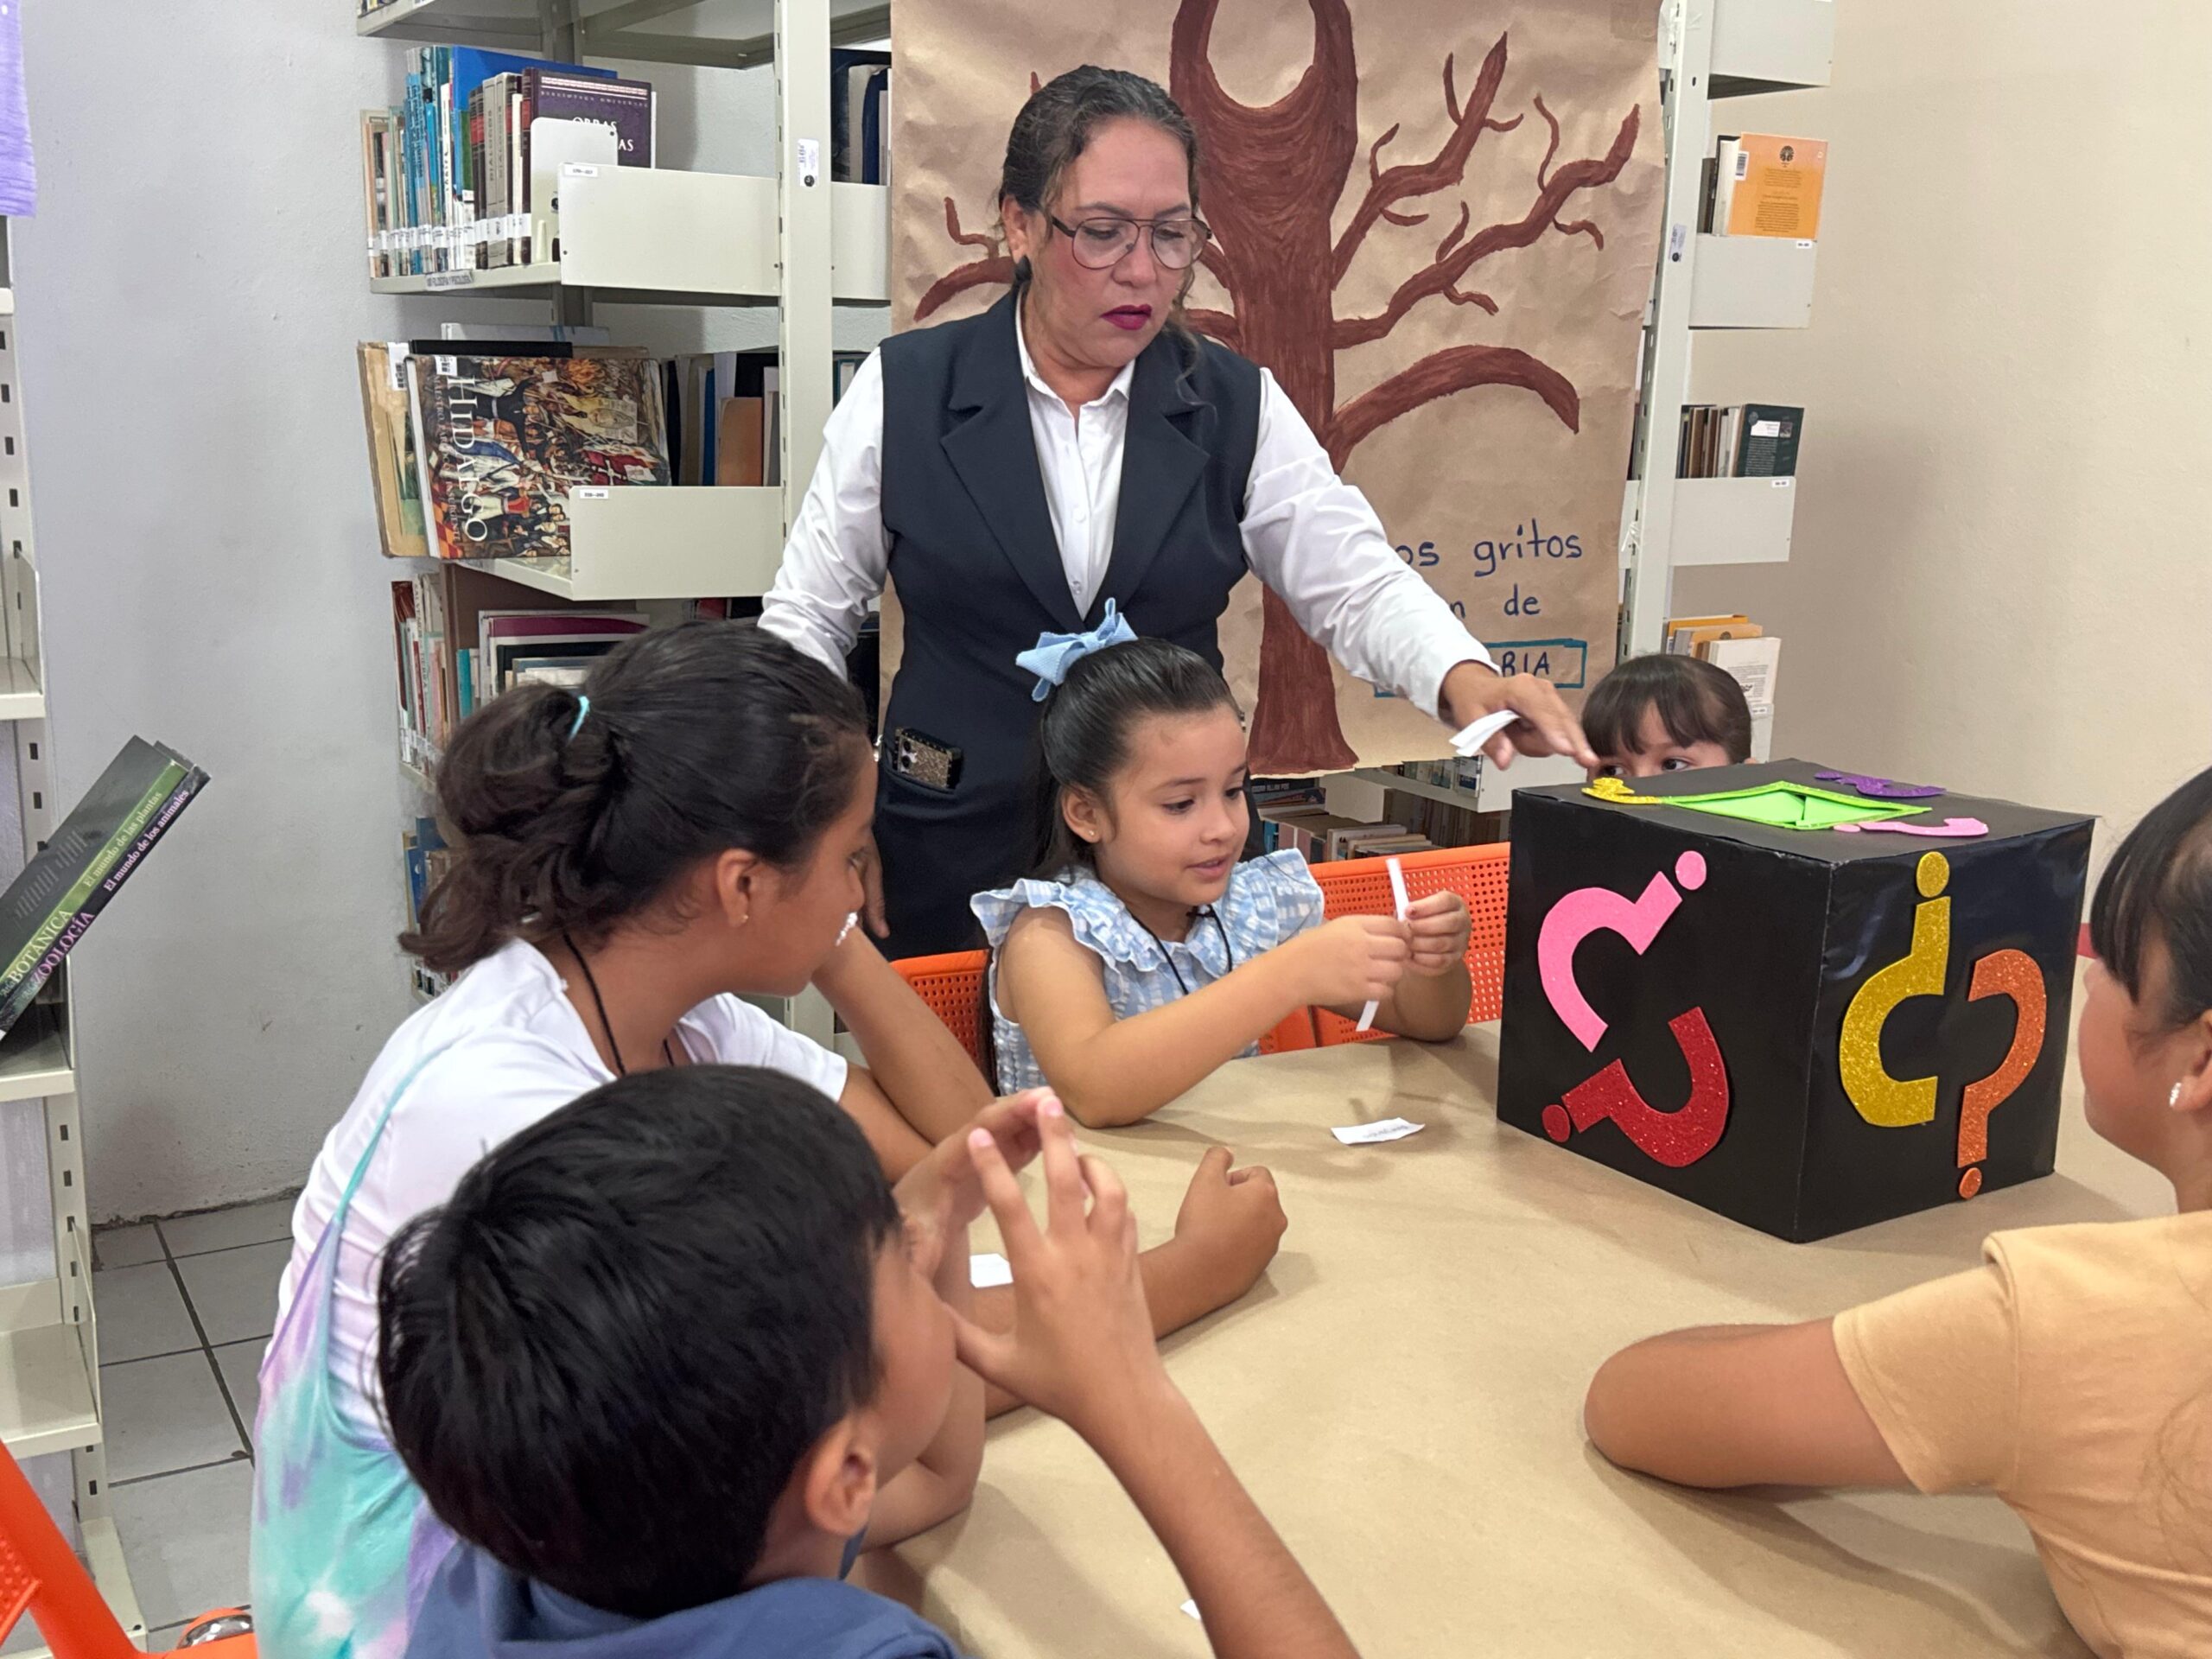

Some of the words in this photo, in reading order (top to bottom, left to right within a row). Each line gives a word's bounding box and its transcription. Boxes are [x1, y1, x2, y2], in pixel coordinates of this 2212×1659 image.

[619, 139, 634, 152] AS
[447, 375, 487, 542] HIDALGO
[1395, 541, 1440, 567] os
[1473, 518, 1583, 577] gritos
[1503, 583, 1541, 617] de
[1502, 650, 1550, 677] RIA
[156, 789, 190, 829] animales
[137, 838, 150, 853] de
[143, 826, 161, 842] los
[113, 850, 141, 881] mundo
[7, 910, 74, 984] BOTÁNICA
[83, 877, 96, 888] El
[92, 846, 120, 877] mundo
[116, 834, 129, 848] de
[124, 822, 139, 837] las
[136, 791, 163, 824] plantas
[103, 878, 117, 892] El
[29, 912, 95, 986] ZOOLOGÍA
